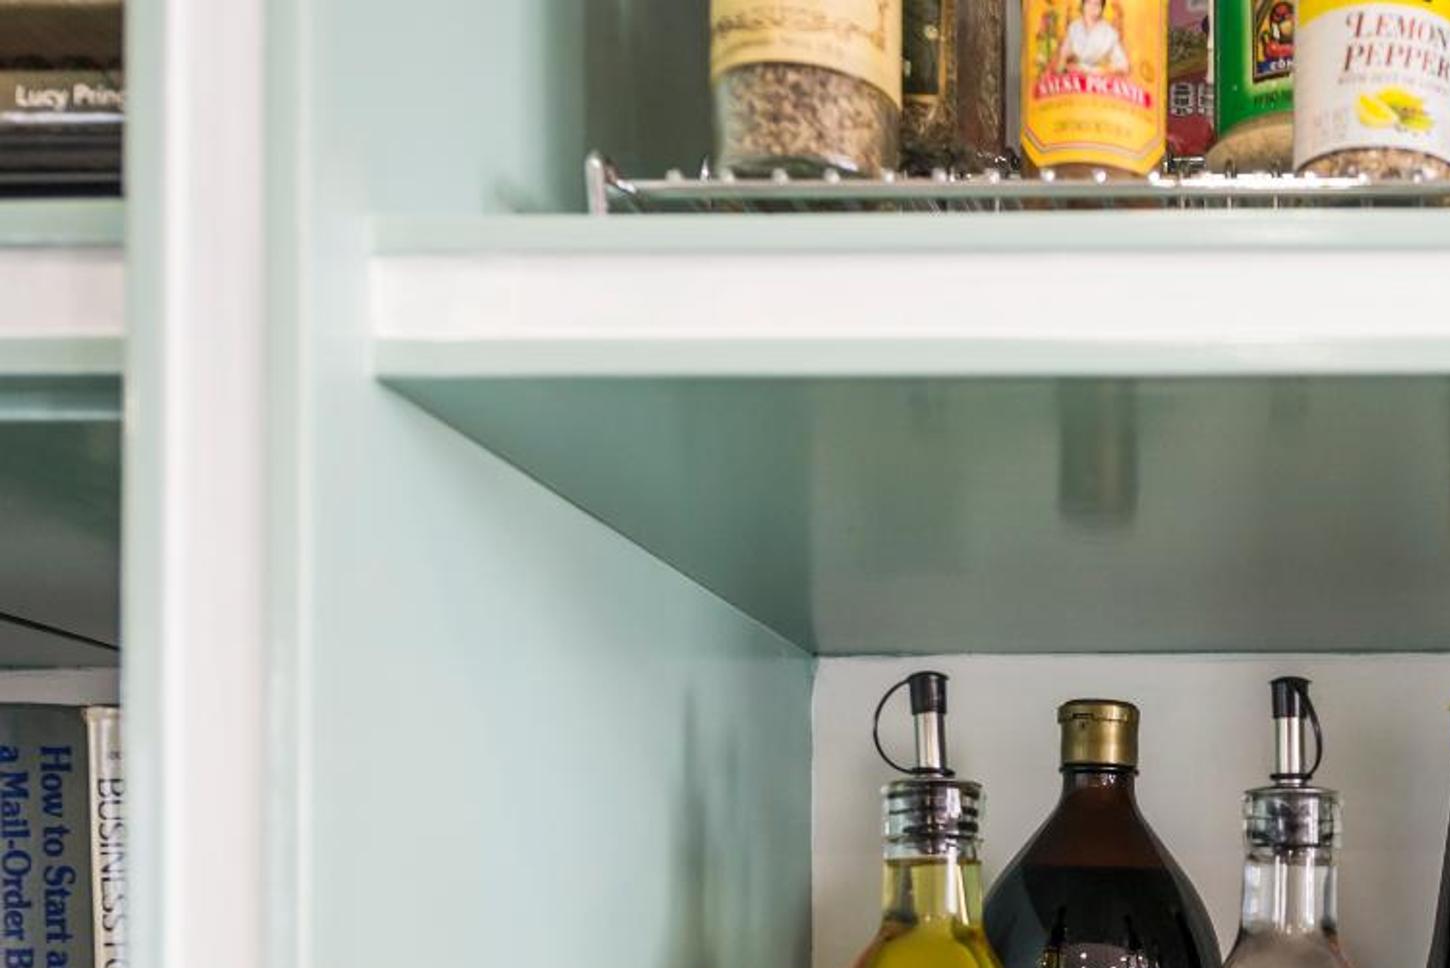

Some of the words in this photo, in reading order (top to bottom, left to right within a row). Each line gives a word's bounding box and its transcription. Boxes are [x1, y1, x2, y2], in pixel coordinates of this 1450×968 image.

[1346, 12, 1448, 48] LEMON
[1344, 46, 1450, 80] PEPPER
[15, 84, 68, 111] Lucy
[40, 746, 73, 818] How
[0, 770, 35, 941] Mail-Order
[43, 824, 71, 857] to
[43, 864, 77, 943] Start
